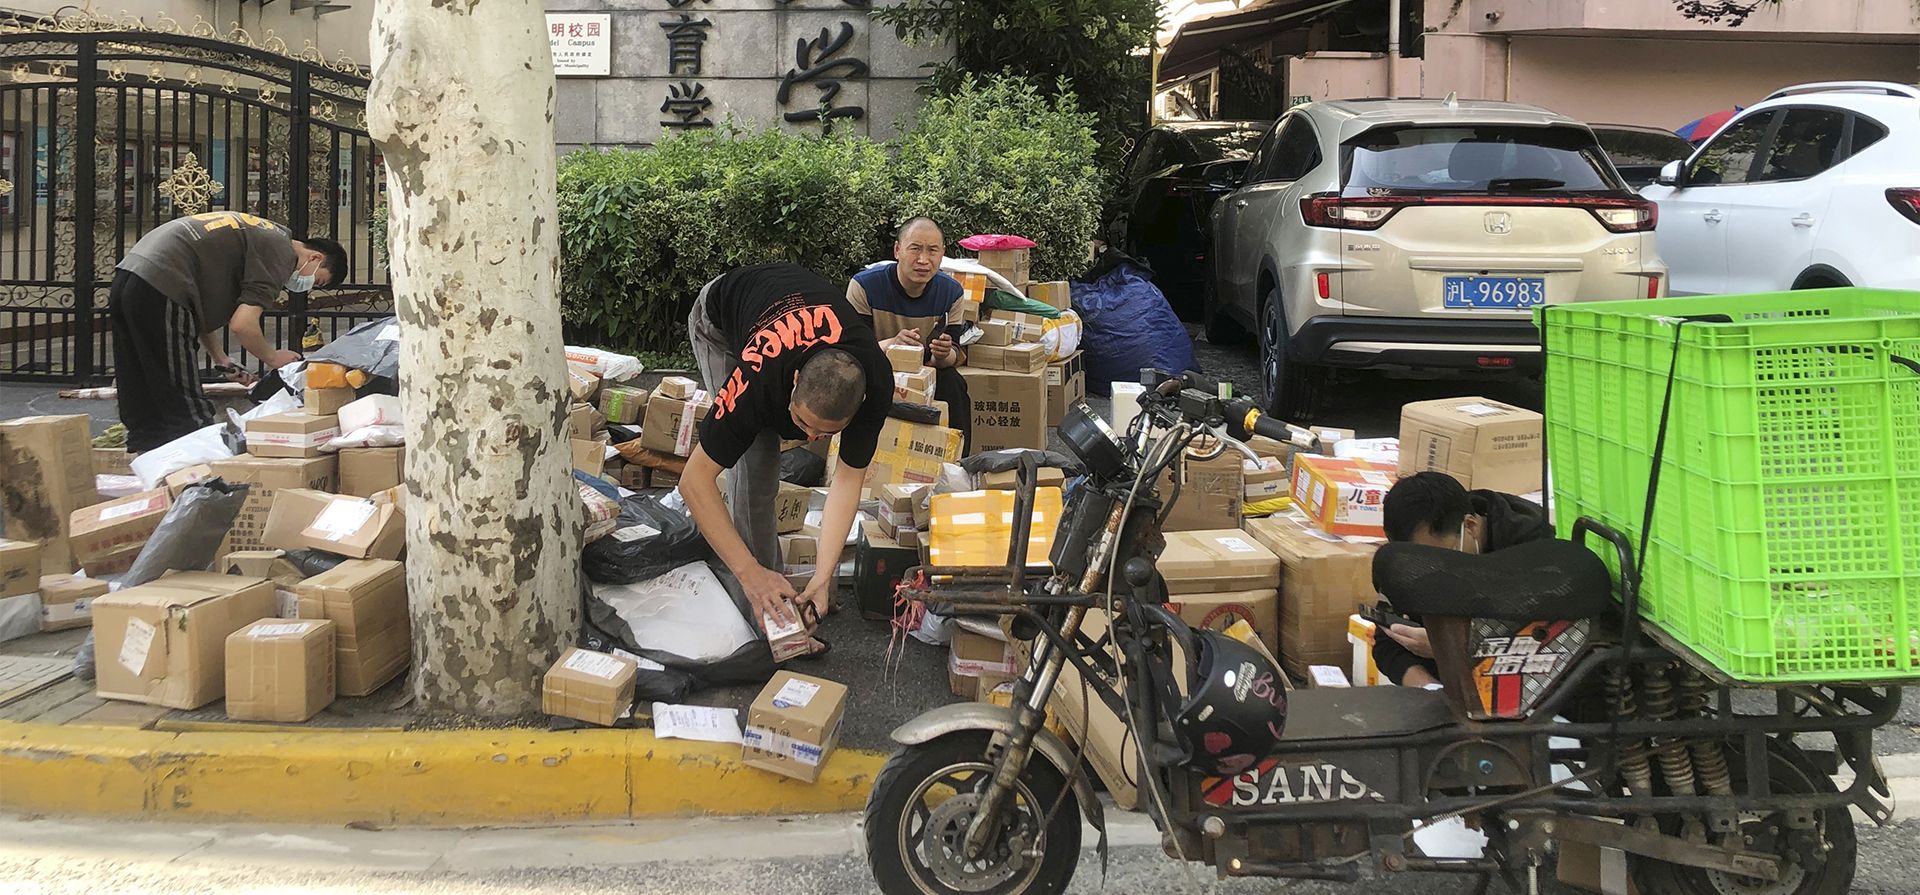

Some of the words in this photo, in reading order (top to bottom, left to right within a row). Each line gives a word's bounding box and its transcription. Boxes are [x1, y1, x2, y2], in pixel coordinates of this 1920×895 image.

[551, 22, 600, 38] 明校园
[567, 39, 595, 47] Campus
[659, 0, 714, 130] 育学
[776, 0, 869, 138] 学
[973, 400, 1021, 413] 玻璃制品
[973, 415, 1021, 428] 小心轻放
[1348, 488, 1391, 506] 儿童
[1231, 763, 1385, 806] SANS
